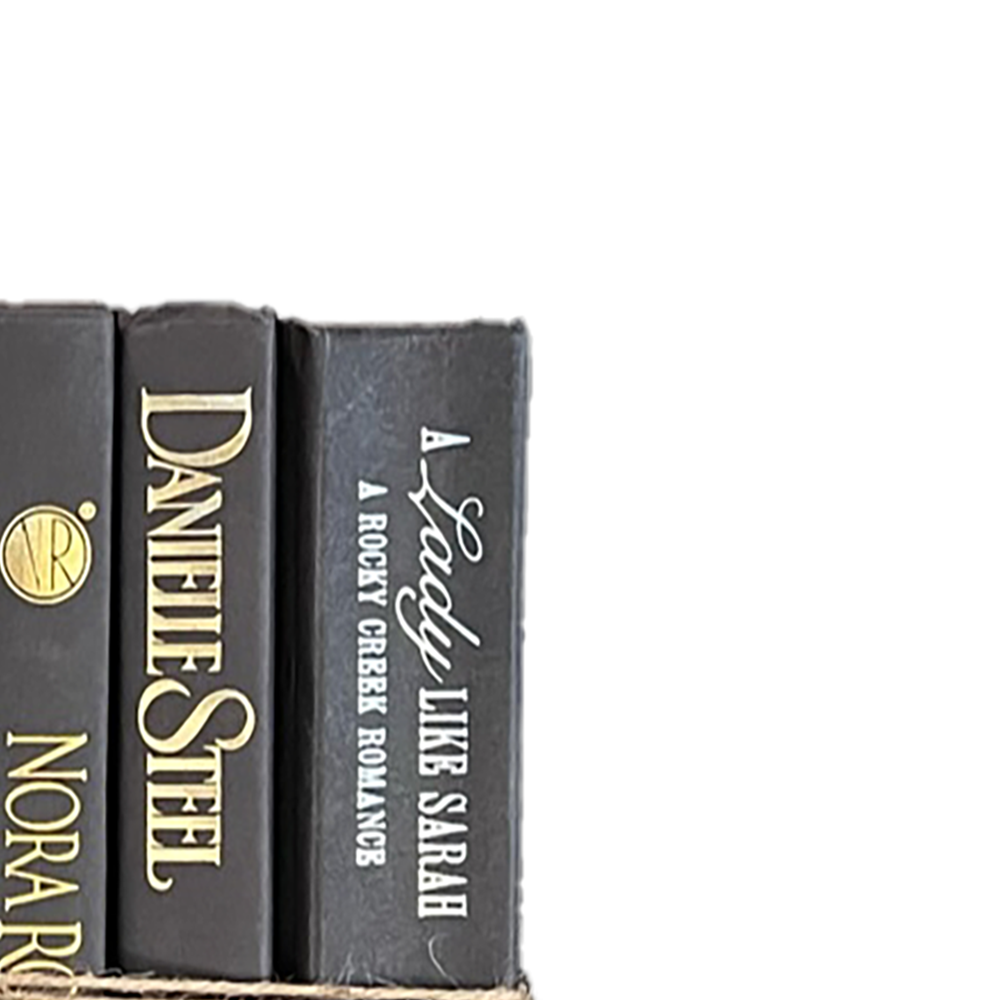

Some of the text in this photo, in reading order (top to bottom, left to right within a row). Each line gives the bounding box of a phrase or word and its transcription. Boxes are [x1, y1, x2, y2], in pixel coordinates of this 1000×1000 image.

[140, 386, 254, 676] DANIELLE
[355, 479, 389, 867] A ROCKY CREEK ROMANCE
[394, 426, 484, 919] A Lady LIKE SARAH
[4, 731, 88, 912] NORA
[136, 677, 256, 892] STEEL
